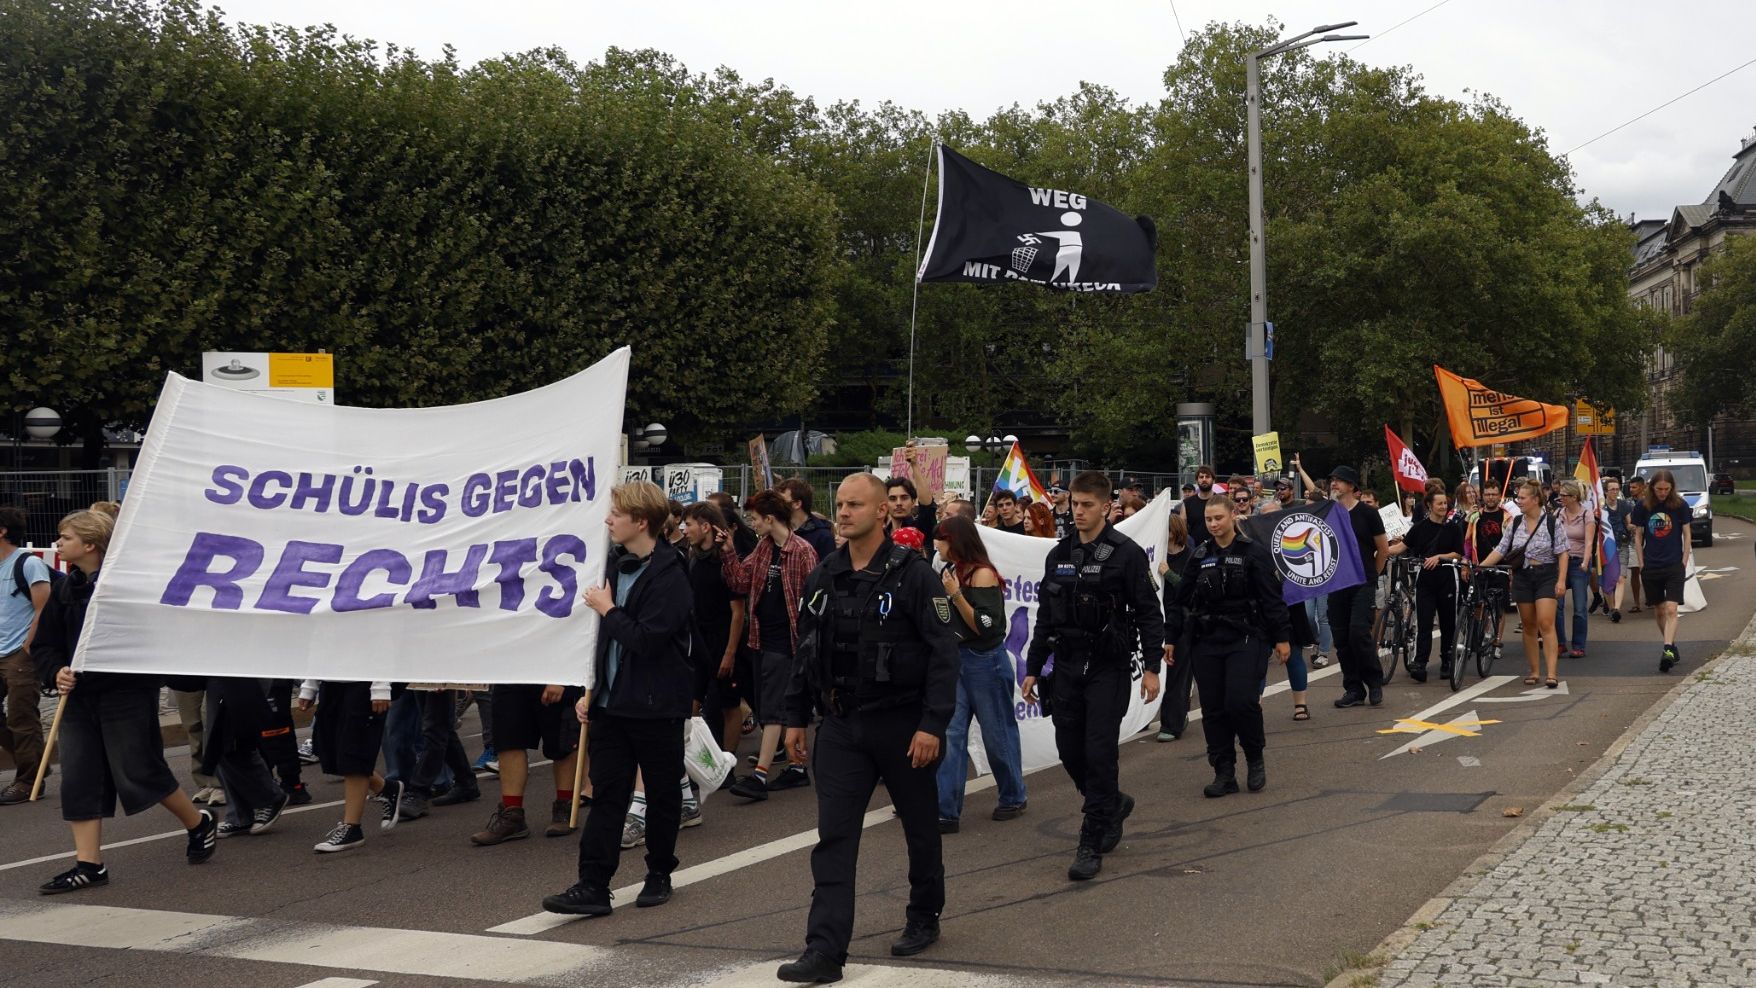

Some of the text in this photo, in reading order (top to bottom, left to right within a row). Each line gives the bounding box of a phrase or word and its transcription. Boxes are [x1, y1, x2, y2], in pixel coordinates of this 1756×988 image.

[1028, 187, 1087, 210] WEG
[962, 261, 1001, 280] MIT
[1477, 415, 1521, 433] illegal
[205, 456, 596, 524] SCHÜLIS GEGEN
[1273, 514, 1334, 554] QUEER AND ANTIFASCIST
[161, 532, 587, 619] RECHTS
[1287, 557, 1337, 585] UNITE AND RESIST
